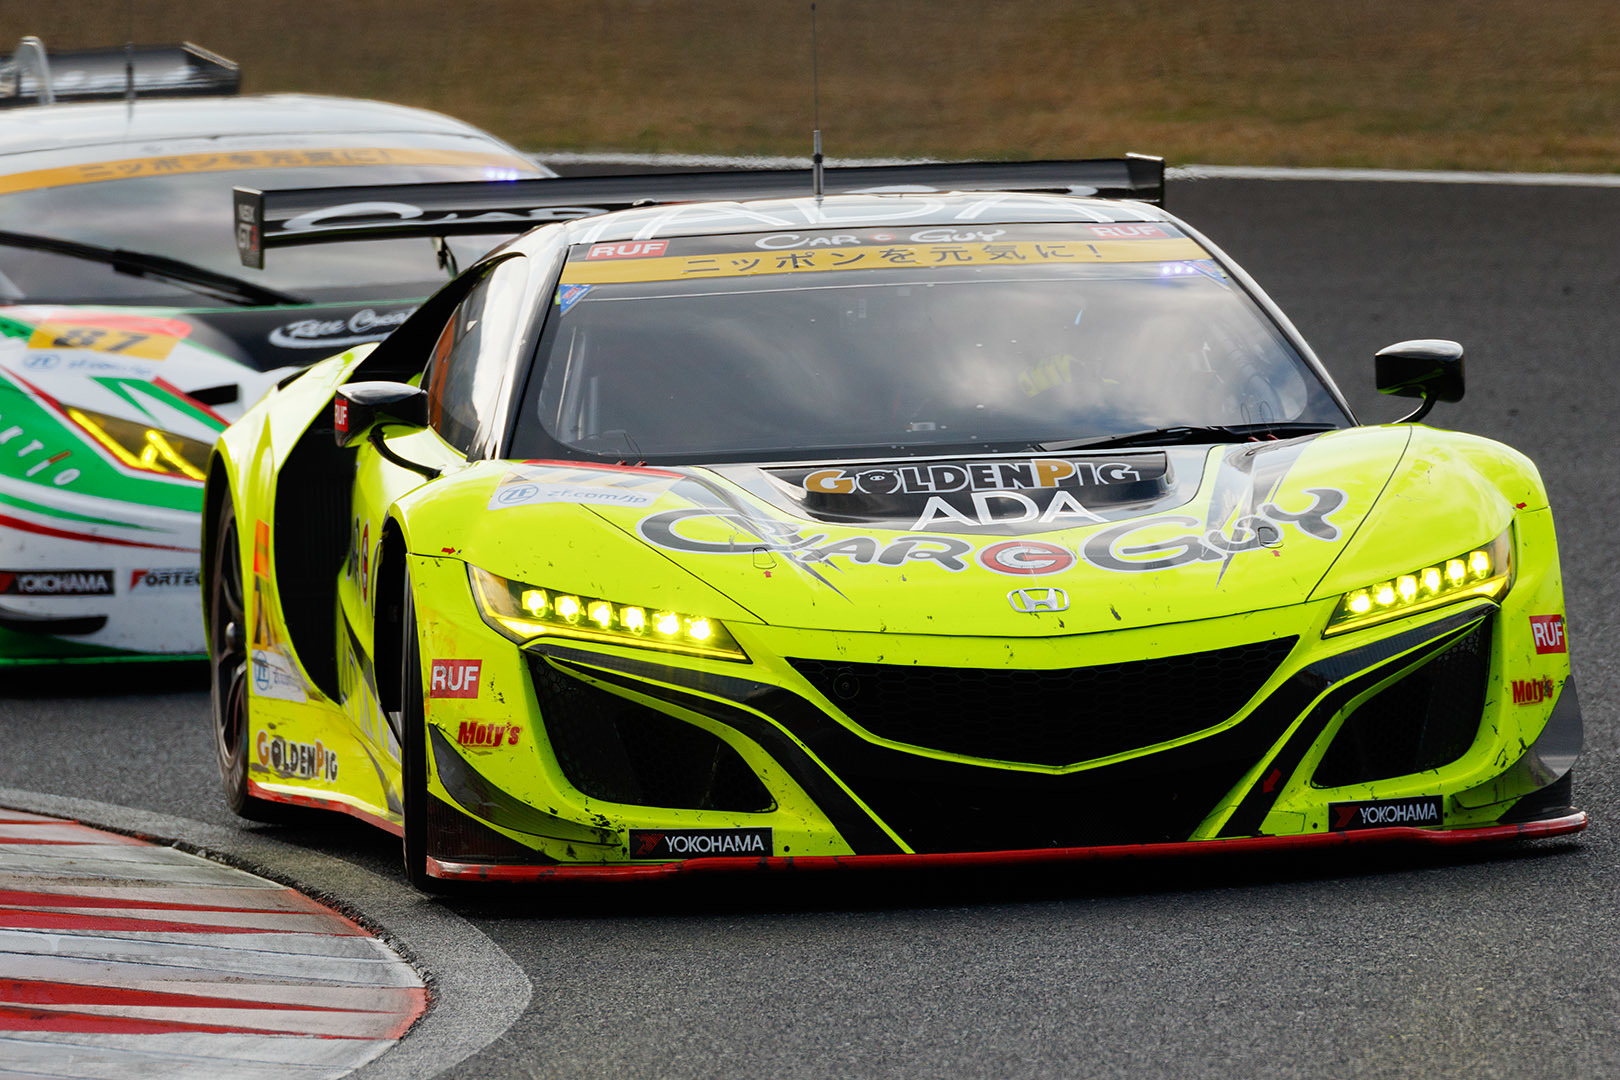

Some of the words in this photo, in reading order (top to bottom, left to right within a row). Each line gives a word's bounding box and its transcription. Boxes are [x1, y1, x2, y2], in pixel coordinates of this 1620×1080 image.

[755, 234, 861, 250] CAR
[909, 228, 1006, 243] GUY
[1090, 225, 1159, 238] RUF
[592, 243, 664, 257] RUF
[910, 490, 1111, 531] ADA
[16, 573, 109, 592] YOKOHAMA
[1532, 621, 1563, 647] RUF
[431, 665, 479, 691] RUF
[457, 721, 521, 748] Moty's
[1360, 803, 1438, 824] YOKOHAMA
[665, 834, 765, 852] YOKOHAMA
